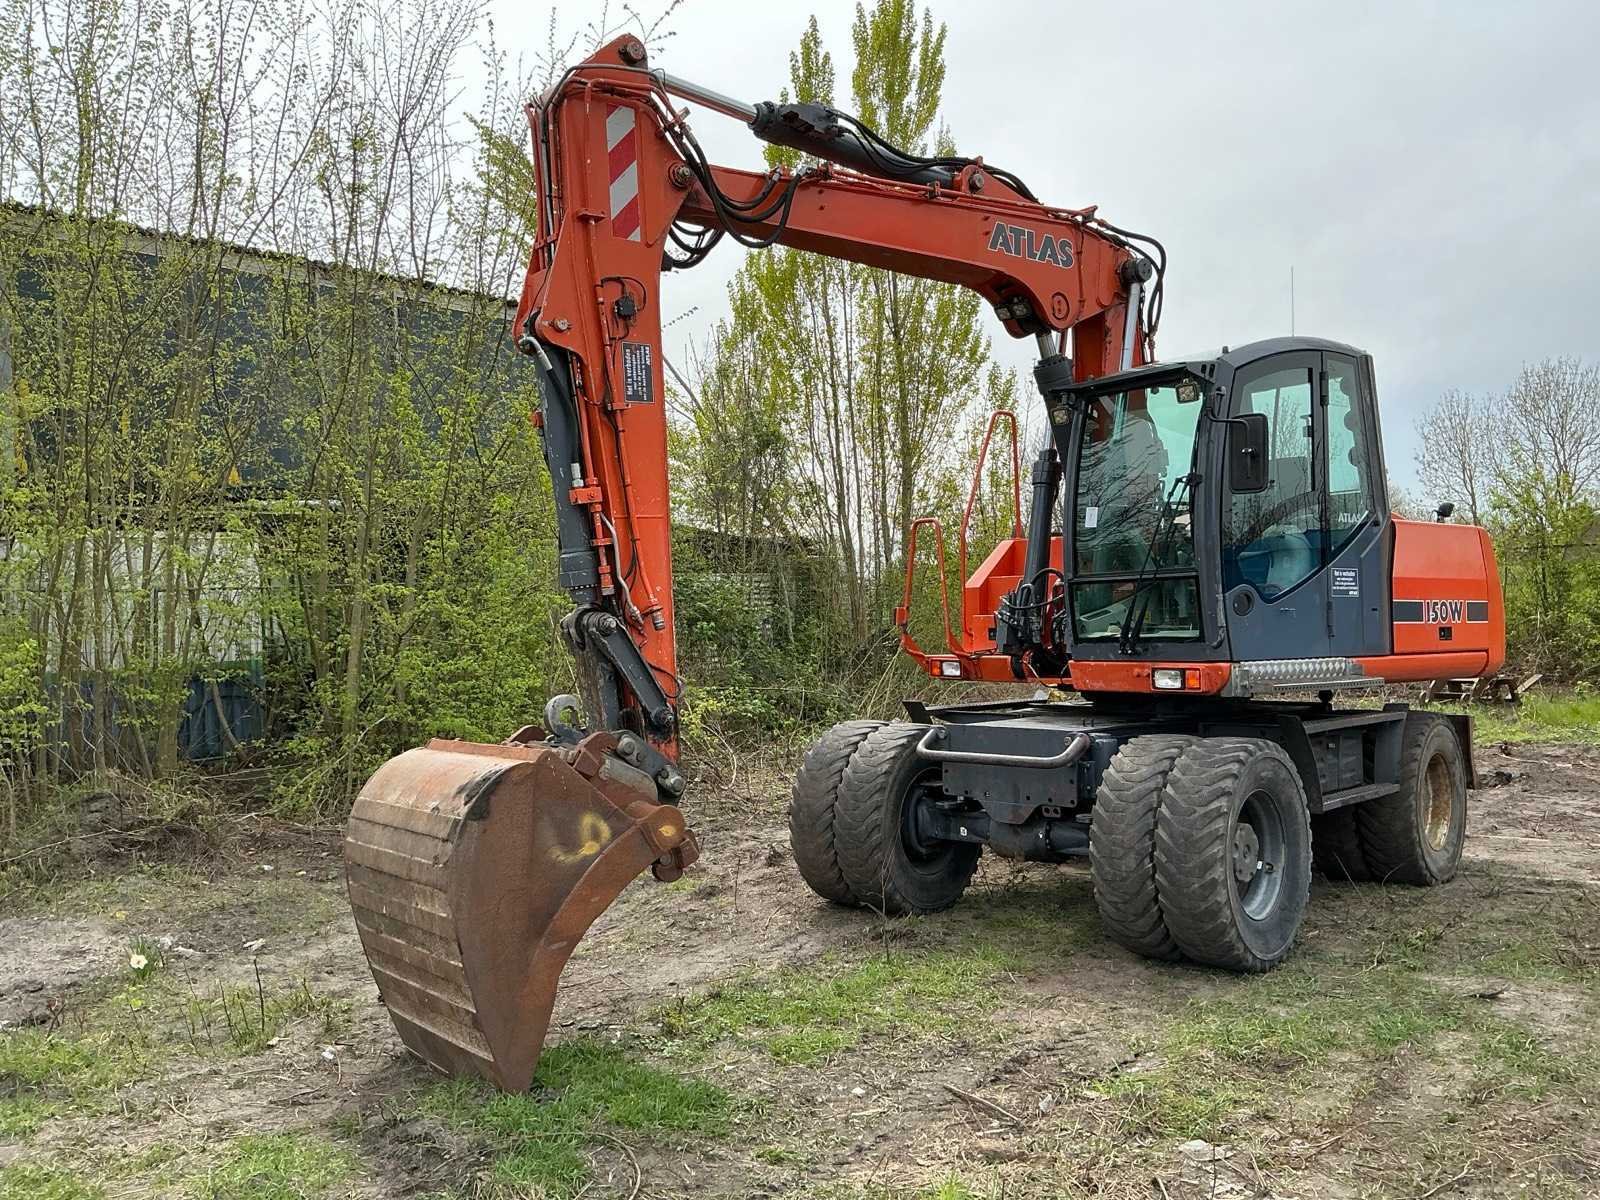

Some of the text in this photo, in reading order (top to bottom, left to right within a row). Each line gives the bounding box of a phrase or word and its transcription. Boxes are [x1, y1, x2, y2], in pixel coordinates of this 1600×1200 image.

[987, 221, 1075, 269] ATLAS
[1338, 512, 1361, 523] ATLAS
[1425, 600, 1464, 624] 150W
